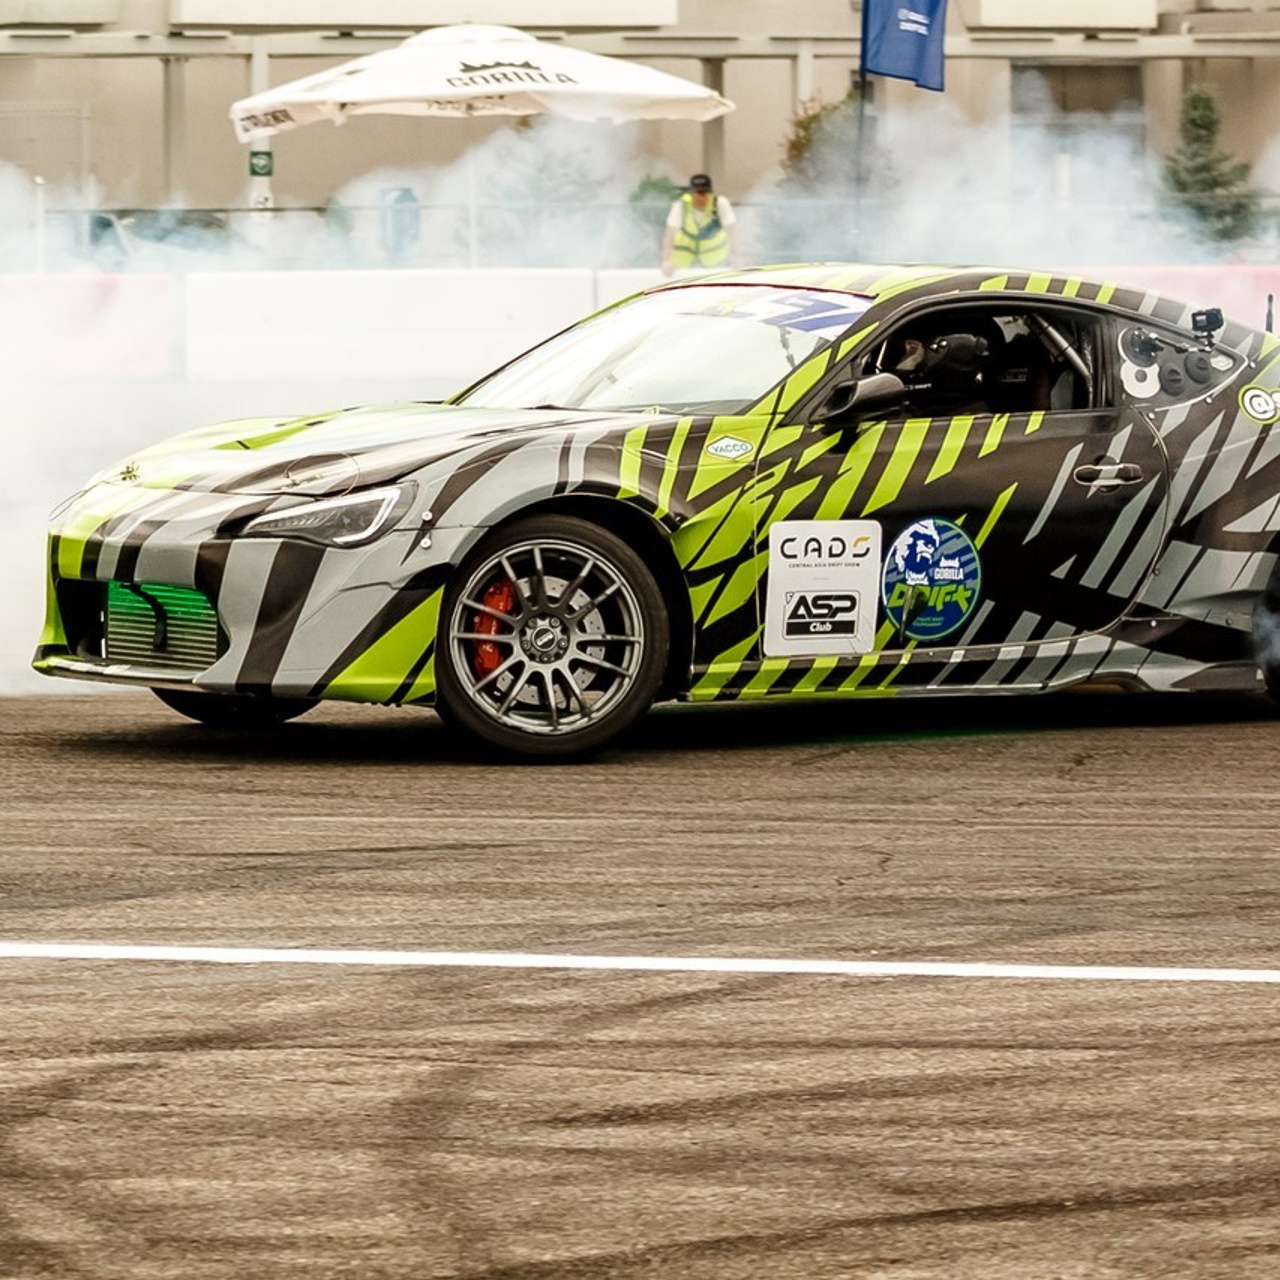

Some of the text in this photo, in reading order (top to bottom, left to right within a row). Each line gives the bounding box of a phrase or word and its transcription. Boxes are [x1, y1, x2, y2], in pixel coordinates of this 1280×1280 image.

[446, 70, 578, 88] GORILLA
[711, 444, 748, 453] YACCO
[780, 536, 871, 559] CADS
[934, 567, 964, 580] GORILLA
[787, 594, 857, 620] ASP
[809, 622, 832, 632] Club
